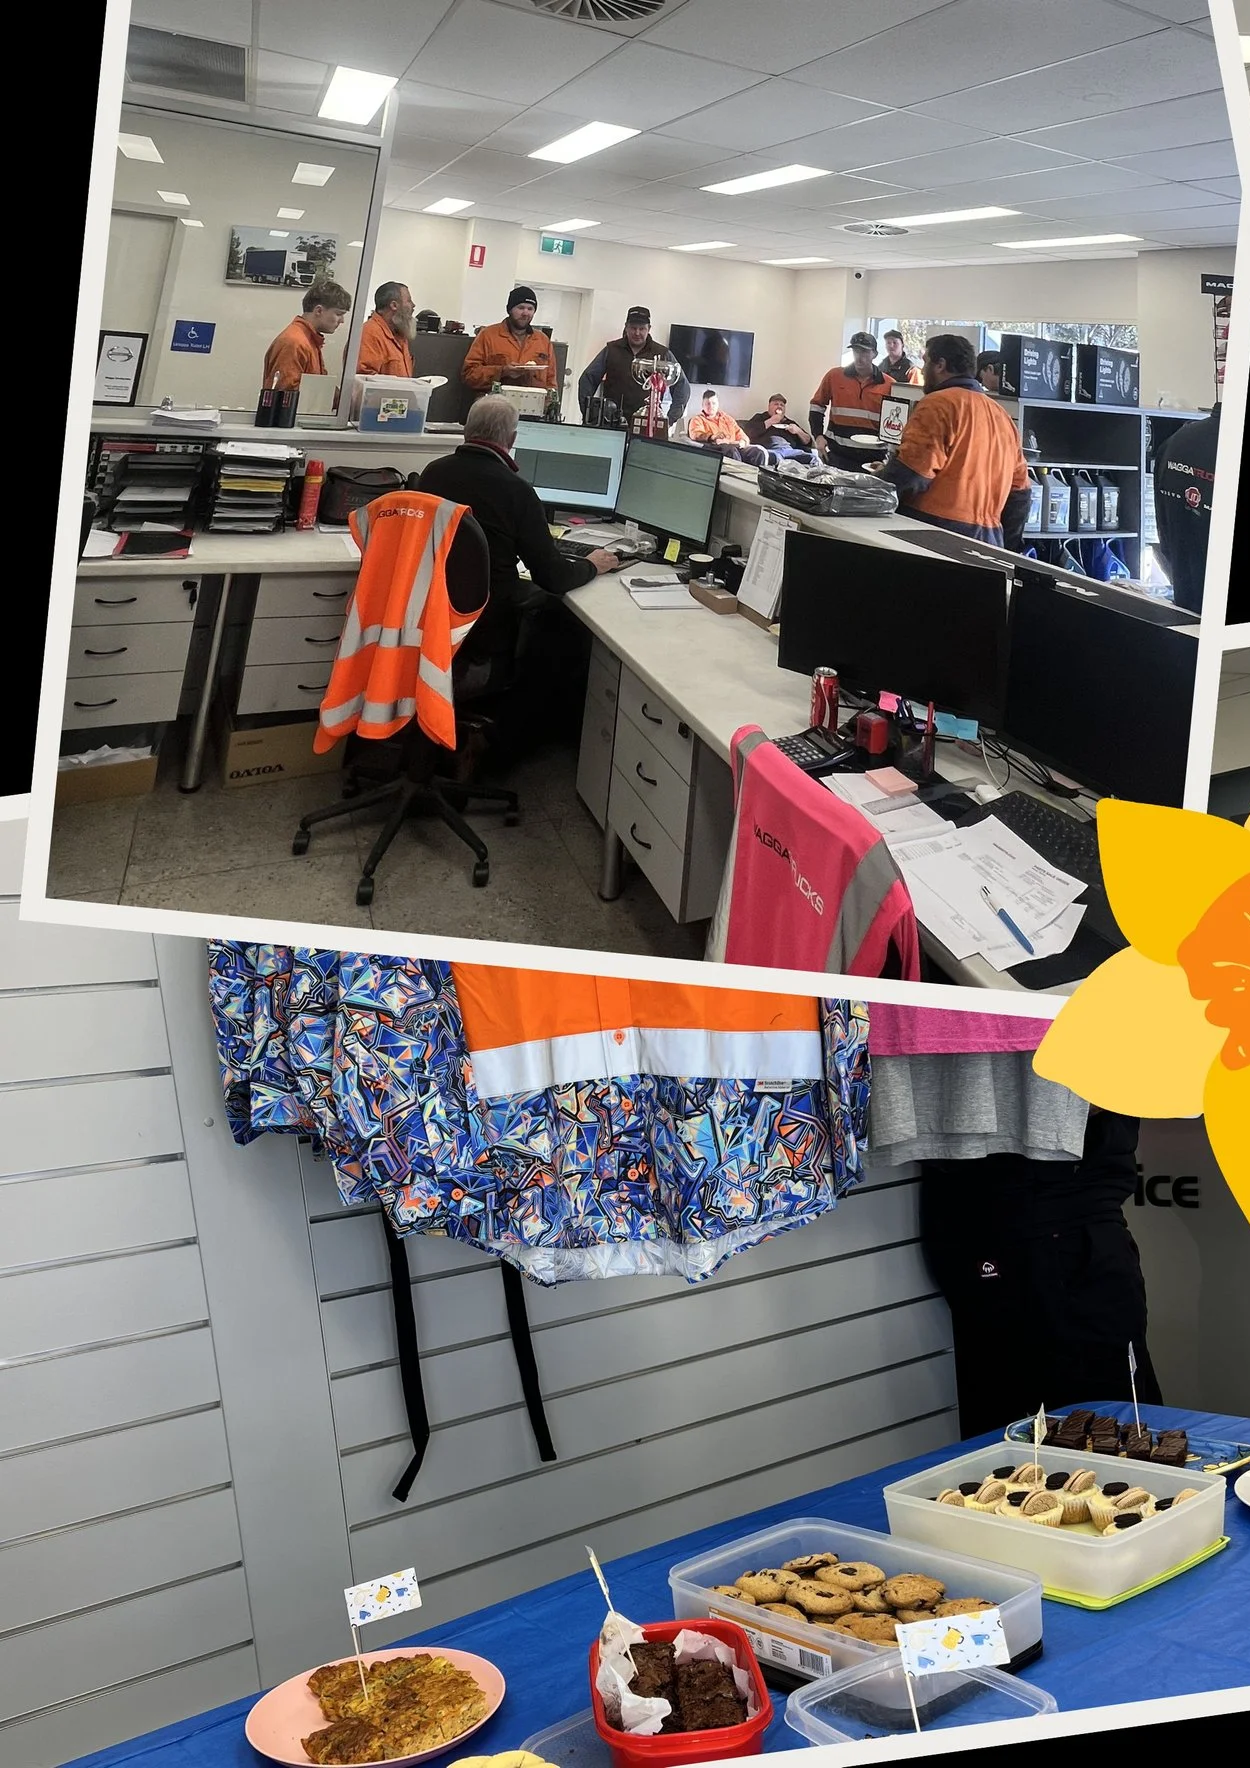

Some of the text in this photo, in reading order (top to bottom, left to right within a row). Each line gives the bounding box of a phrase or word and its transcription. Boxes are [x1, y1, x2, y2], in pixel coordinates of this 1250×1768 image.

[1023, 348, 1040, 360] Driving
[1023, 357, 1038, 367] Lights
[1099, 358, 1114, 369] Driving
[1099, 366, 1112, 375] Lights
[229, 763, 285, 780] VOLVO
